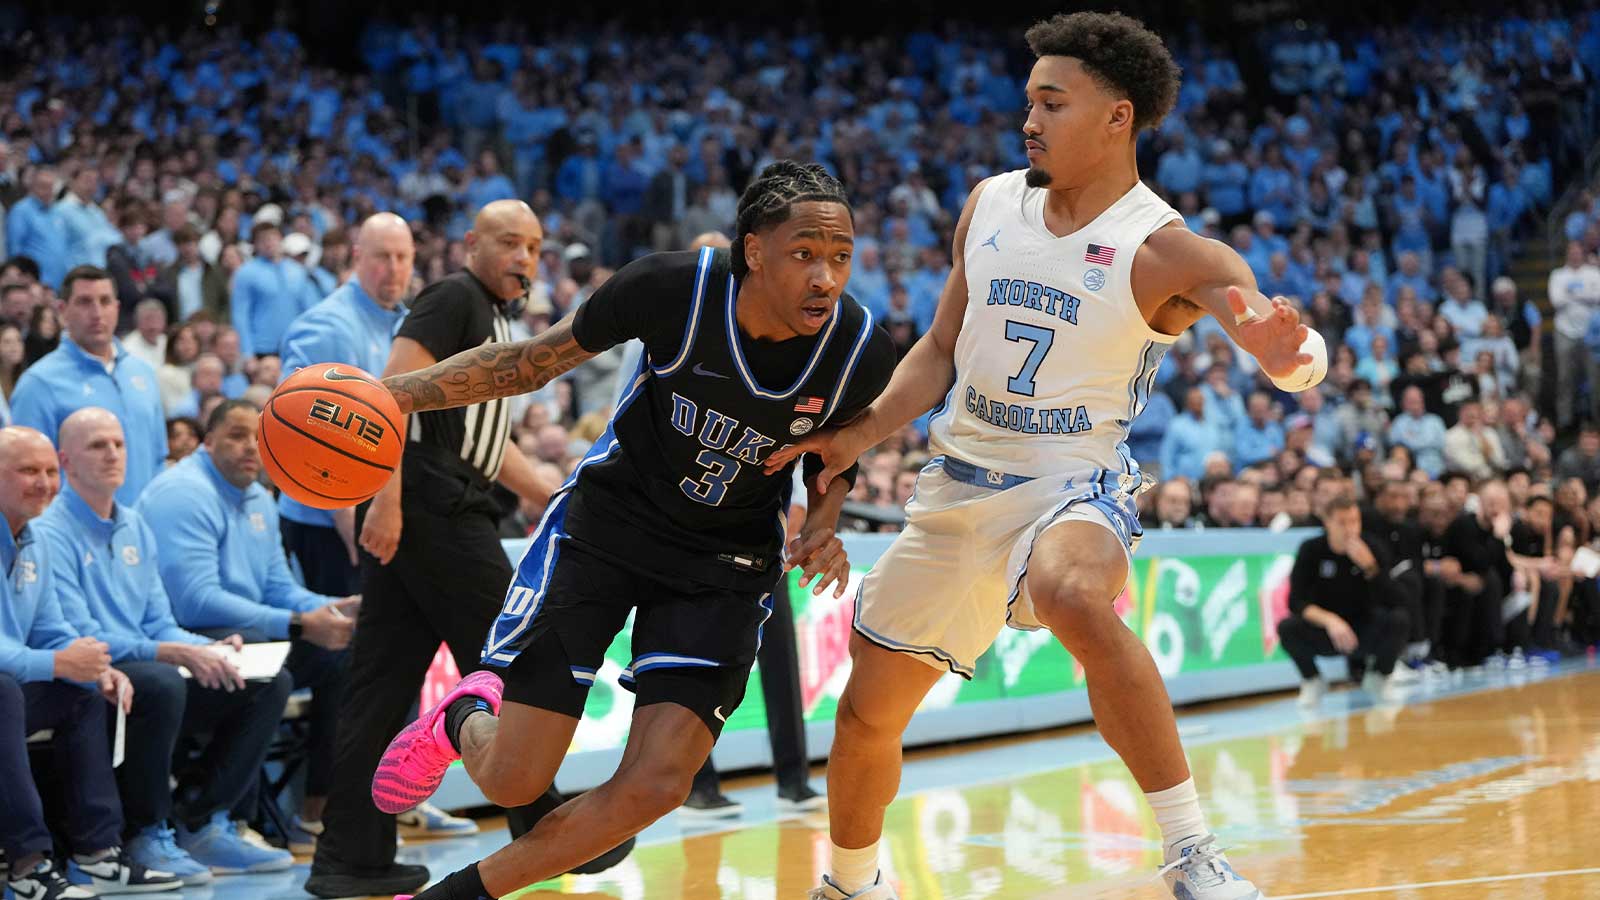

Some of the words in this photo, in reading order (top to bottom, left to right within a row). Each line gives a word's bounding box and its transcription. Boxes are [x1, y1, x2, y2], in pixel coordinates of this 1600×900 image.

[987, 279, 1081, 325] NORTH
[1004, 319, 1055, 397] 7
[309, 399, 384, 447] ELITE
[671, 392, 795, 466] DUK
[965, 385, 1092, 434] CAROLINA
[679, 449, 741, 506] 3
[503, 586, 535, 616] D
